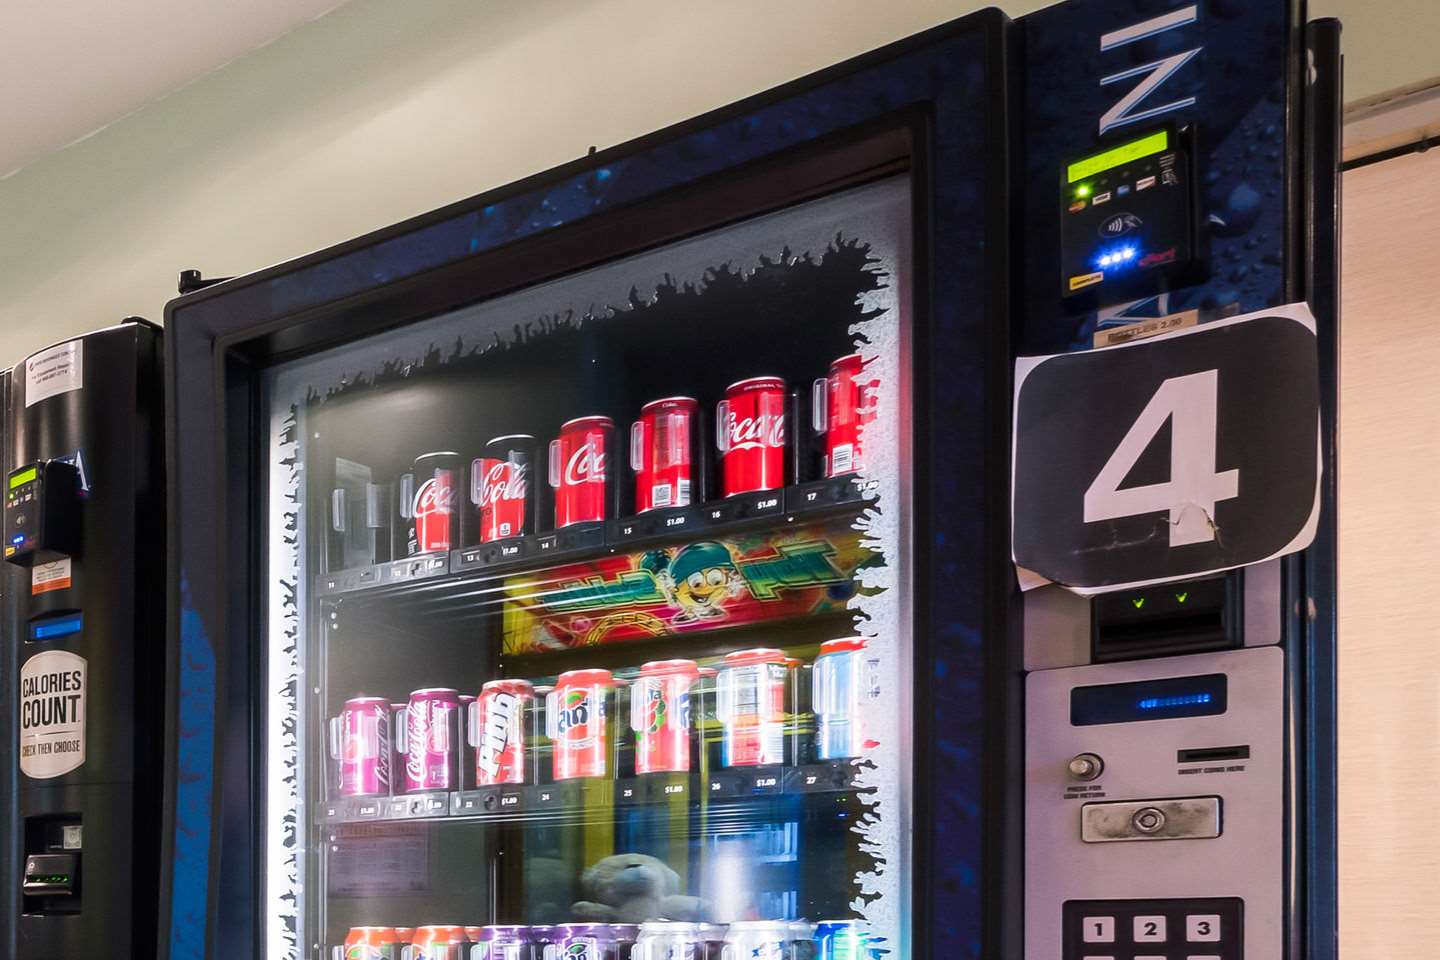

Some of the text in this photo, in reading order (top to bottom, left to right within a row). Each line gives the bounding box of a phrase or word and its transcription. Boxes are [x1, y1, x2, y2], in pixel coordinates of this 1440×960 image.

[1083, 368, 1239, 547] 4
[807, 492, 817, 501] 17
[757, 499, 778, 509] $1.00
[711, 510, 721, 519] 16
[666, 516, 685, 527] $1.00
[623, 526, 633, 535] 15
[23, 671, 81, 698] CALORIES
[23, 695, 81, 729] COUNT
[38, 743, 52, 755] THEN
[54, 740, 80, 754] CHOOSE
[1093, 921, 1211, 936] 1 2 3
